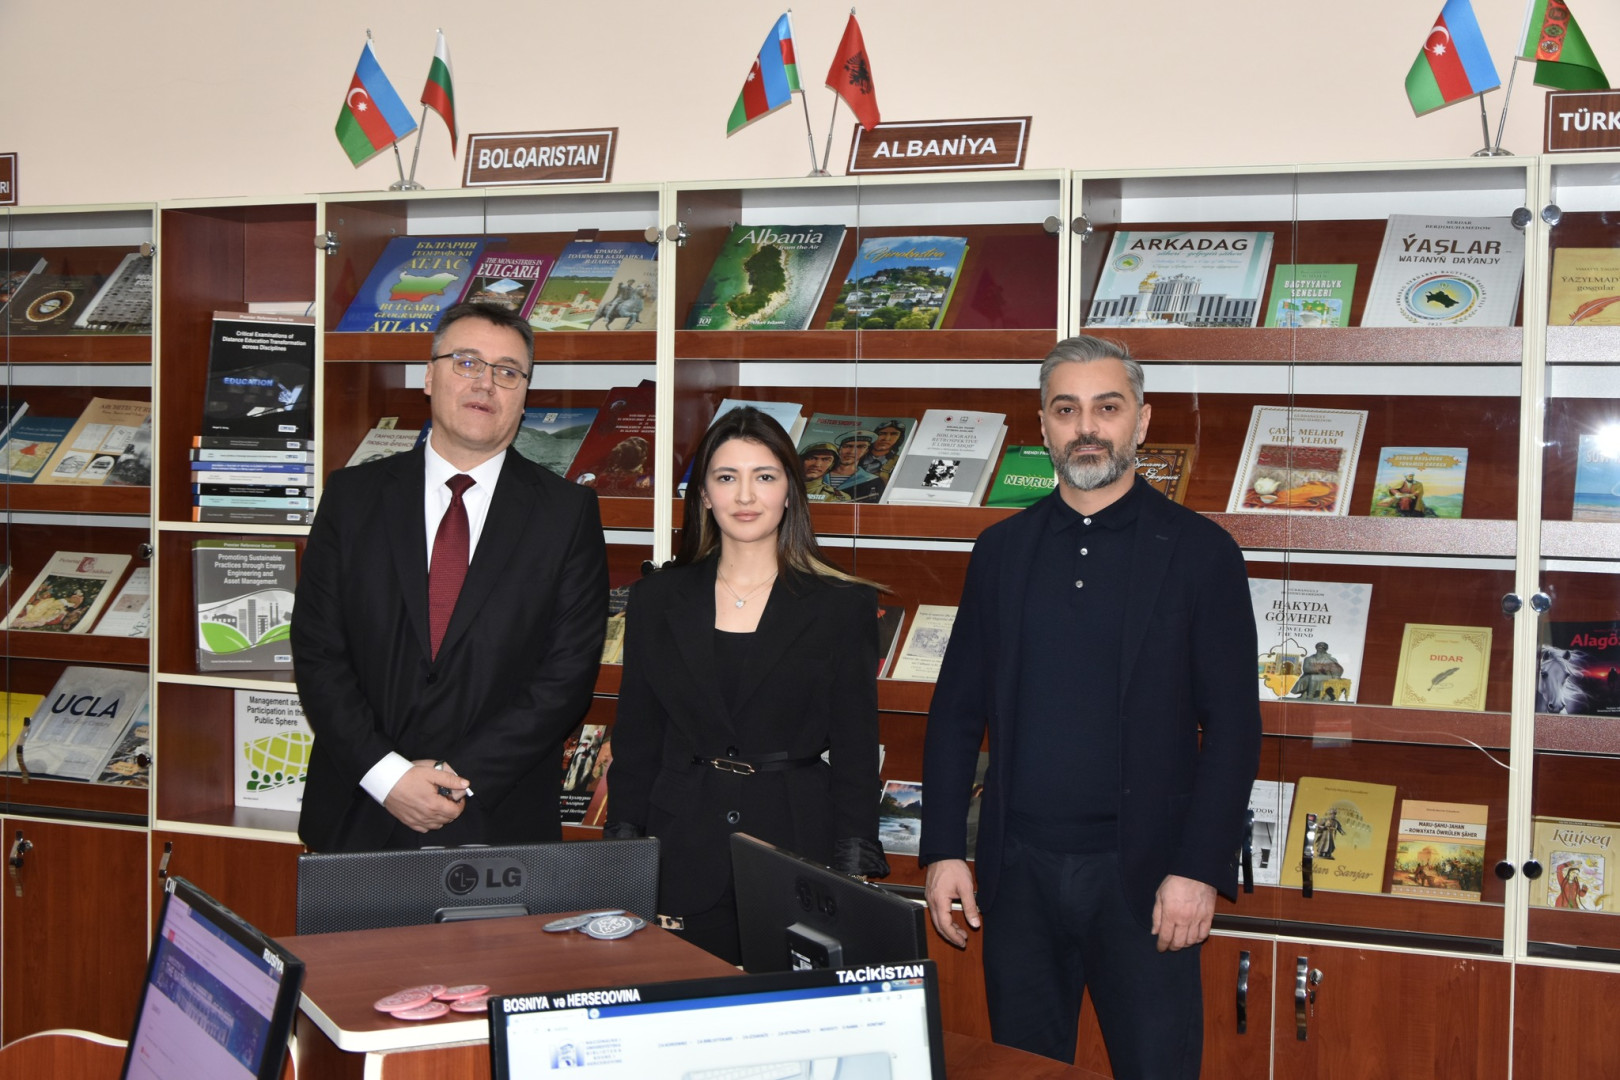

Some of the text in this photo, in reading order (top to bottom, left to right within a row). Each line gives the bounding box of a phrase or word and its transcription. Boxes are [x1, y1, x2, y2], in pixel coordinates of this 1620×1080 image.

[873, 135, 997, 158] ALBANİYA
[478, 145, 600, 169] BOLQARISTAN
[738, 229, 823, 244] Albania
[416, 241, 478, 249] БЪЛГАРИЯ
[1130, 238, 1248, 251] ARKADAG
[1402, 233, 1501, 255] ÝAŞLAR
[1452, 256, 1500, 265] DAÝANJY
[476, 263, 541, 278] BULGARIA
[379, 303, 441, 311] BULGARIA
[374, 311, 437, 319] GEOGRAPHIC
[366, 320, 432, 332] ATLAS
[254, 331, 287, 339] Examinations
[270, 338, 306, 346] Transformation
[223, 377, 274, 387] EDUCATION
[1299, 428, 1344, 437] MELHEM
[1301, 437, 1337, 445] YLHAM
[218, 554, 282, 562] Promoting Sustainable
[265, 563, 286, 571] Energy
[241, 578, 278, 586] Management
[1273, 600, 1329, 612] HAKYDA
[1265, 611, 1332, 625] GÖWHERI
[1430, 654, 1464, 662] DIDAR
[52, 693, 119, 718] UCLA
[249, 696, 289, 706] Management
[247, 705, 286, 716] Participation
[255, 715, 298, 727] Public Sphere
[486, 866, 521, 887] LG
[836, 965, 924, 983] TACİKİSTAN
[503, 988, 641, 1013] BOSNIYA və HERSEQOVINA
